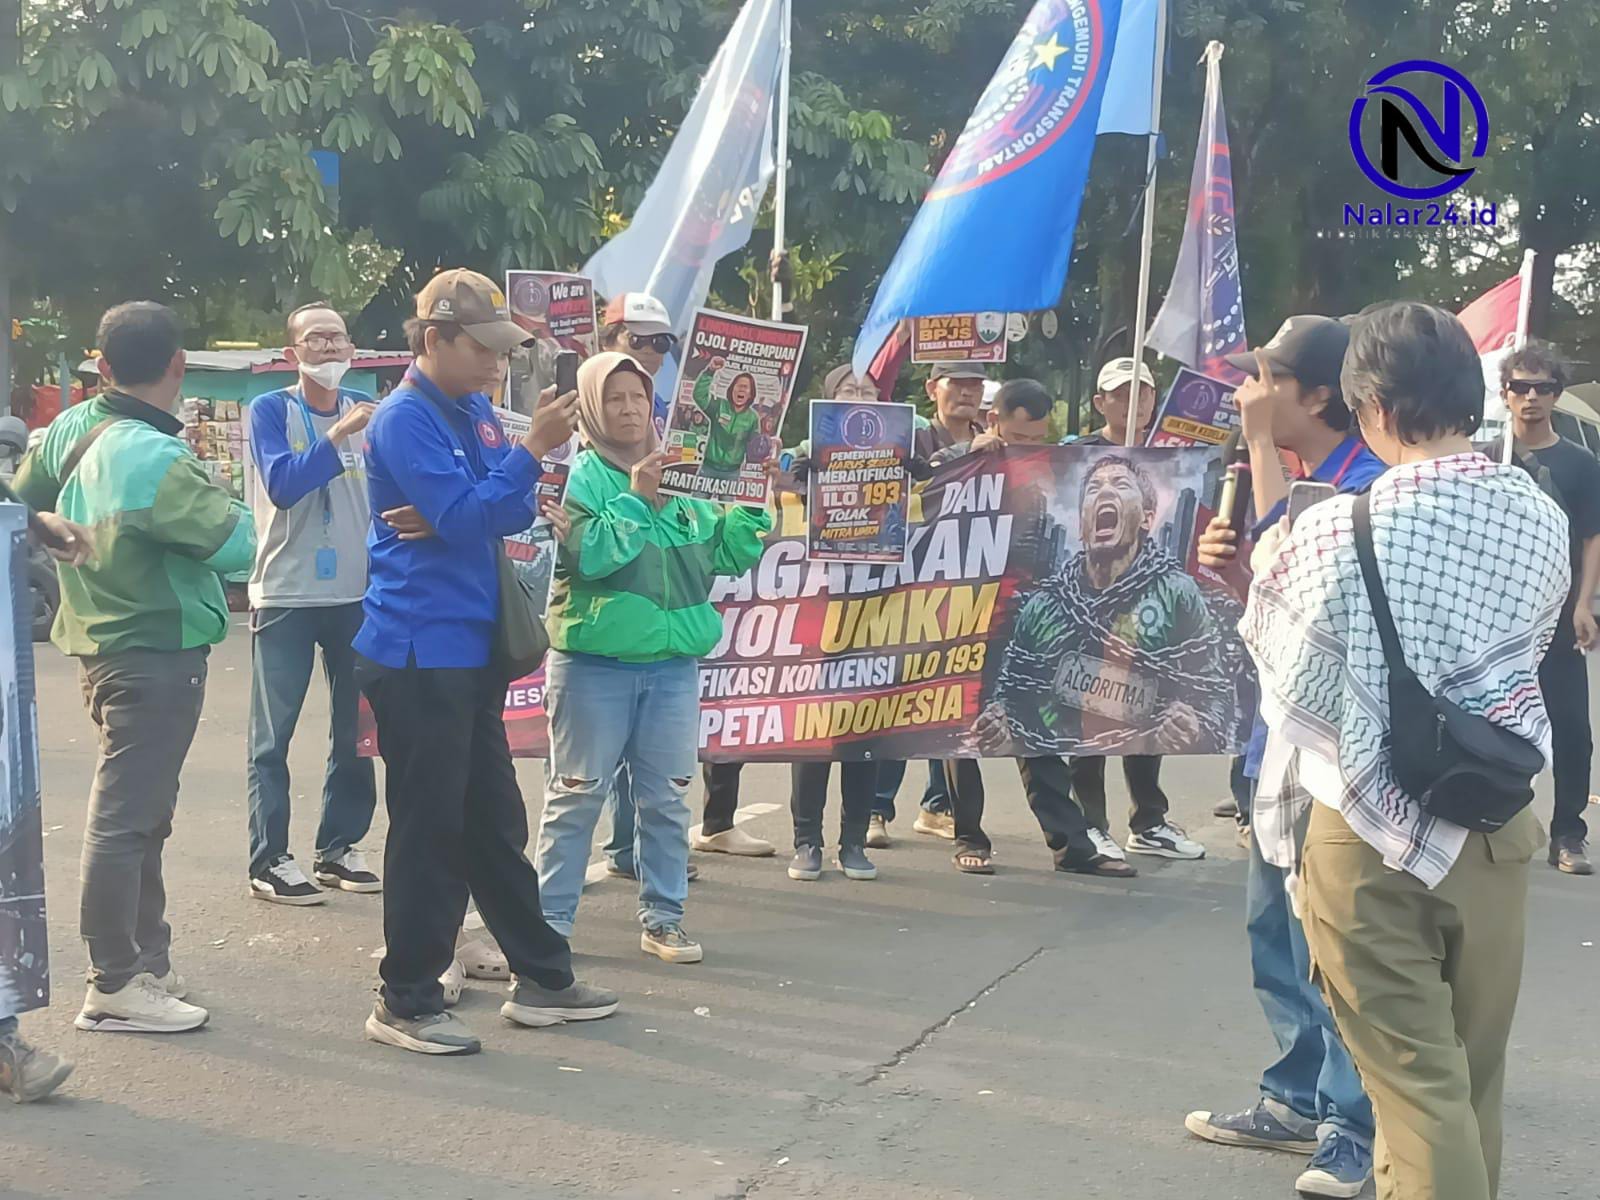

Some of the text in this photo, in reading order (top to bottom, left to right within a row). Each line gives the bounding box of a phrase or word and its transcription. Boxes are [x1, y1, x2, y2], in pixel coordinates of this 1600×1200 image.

[552, 283, 584, 301] We are
[695, 332, 797, 361] OJOL PEREMPUAN
[919, 327, 972, 342] BPJS
[661, 469, 729, 495] #RATIFIKASI
[745, 481, 764, 498] 190
[818, 466, 904, 484] MERATIFIKASI
[823, 491, 858, 507] ILO
[863, 482, 901, 505] 193
[940, 473, 1004, 517] DAN
[826, 507, 871, 522] TOLAK
[819, 582, 1000, 653] UMKM
[778, 656, 895, 695] KONVENSI
[902, 650, 938, 682] ILO
[944, 643, 986, 673] 193
[1062, 668, 1145, 709] ALGORITMA
[699, 685, 963, 748] PETA INDONESIA
